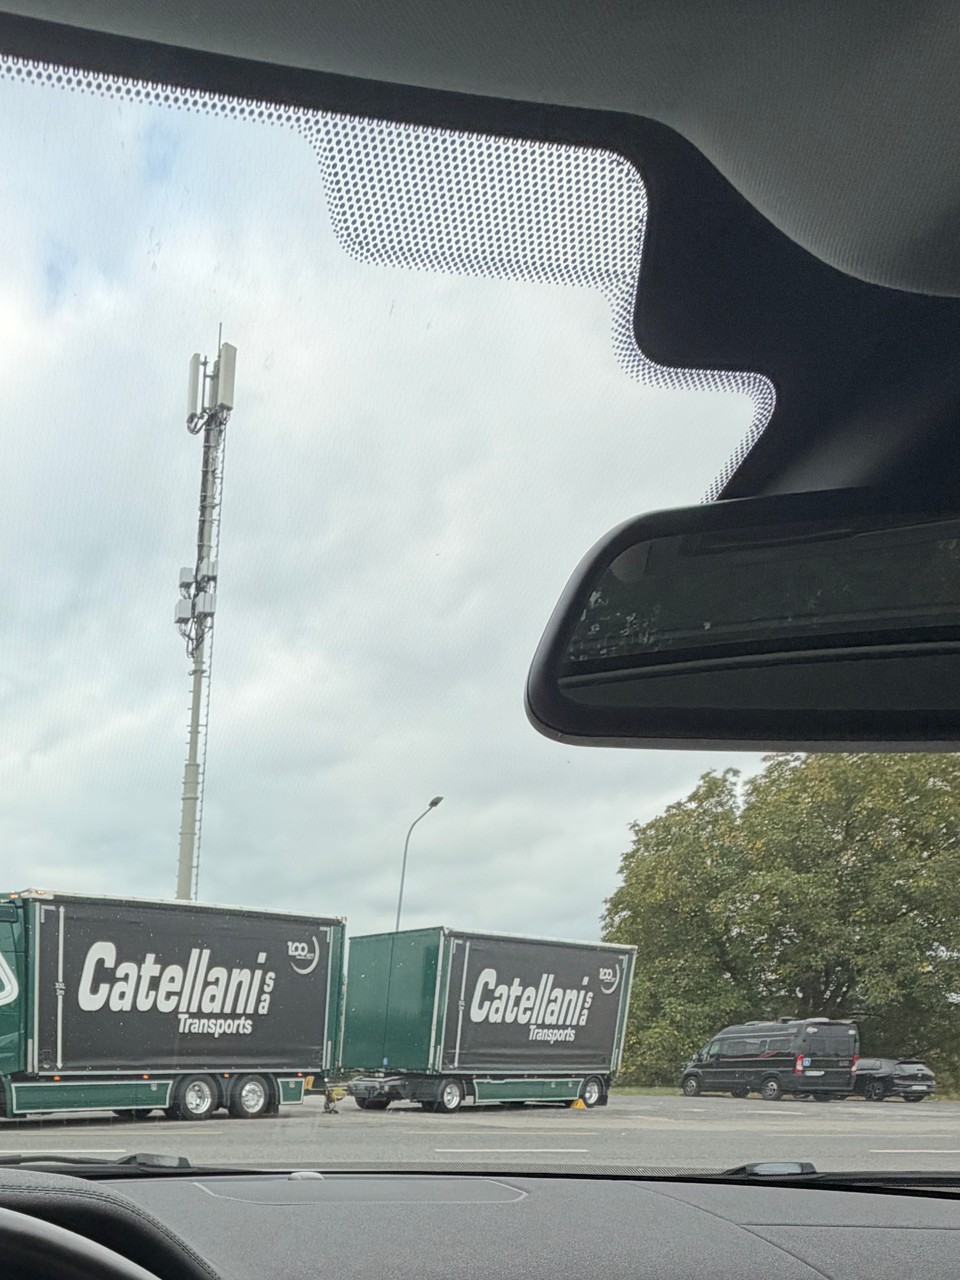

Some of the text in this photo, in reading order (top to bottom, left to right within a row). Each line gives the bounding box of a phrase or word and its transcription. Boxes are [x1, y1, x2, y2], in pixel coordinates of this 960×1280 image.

[78, 941, 267, 1014] Catellani
[470, 968, 589, 1026] Catellani
[177, 1013, 253, 1038] Transports
[529, 1025, 576, 1044] Transports
